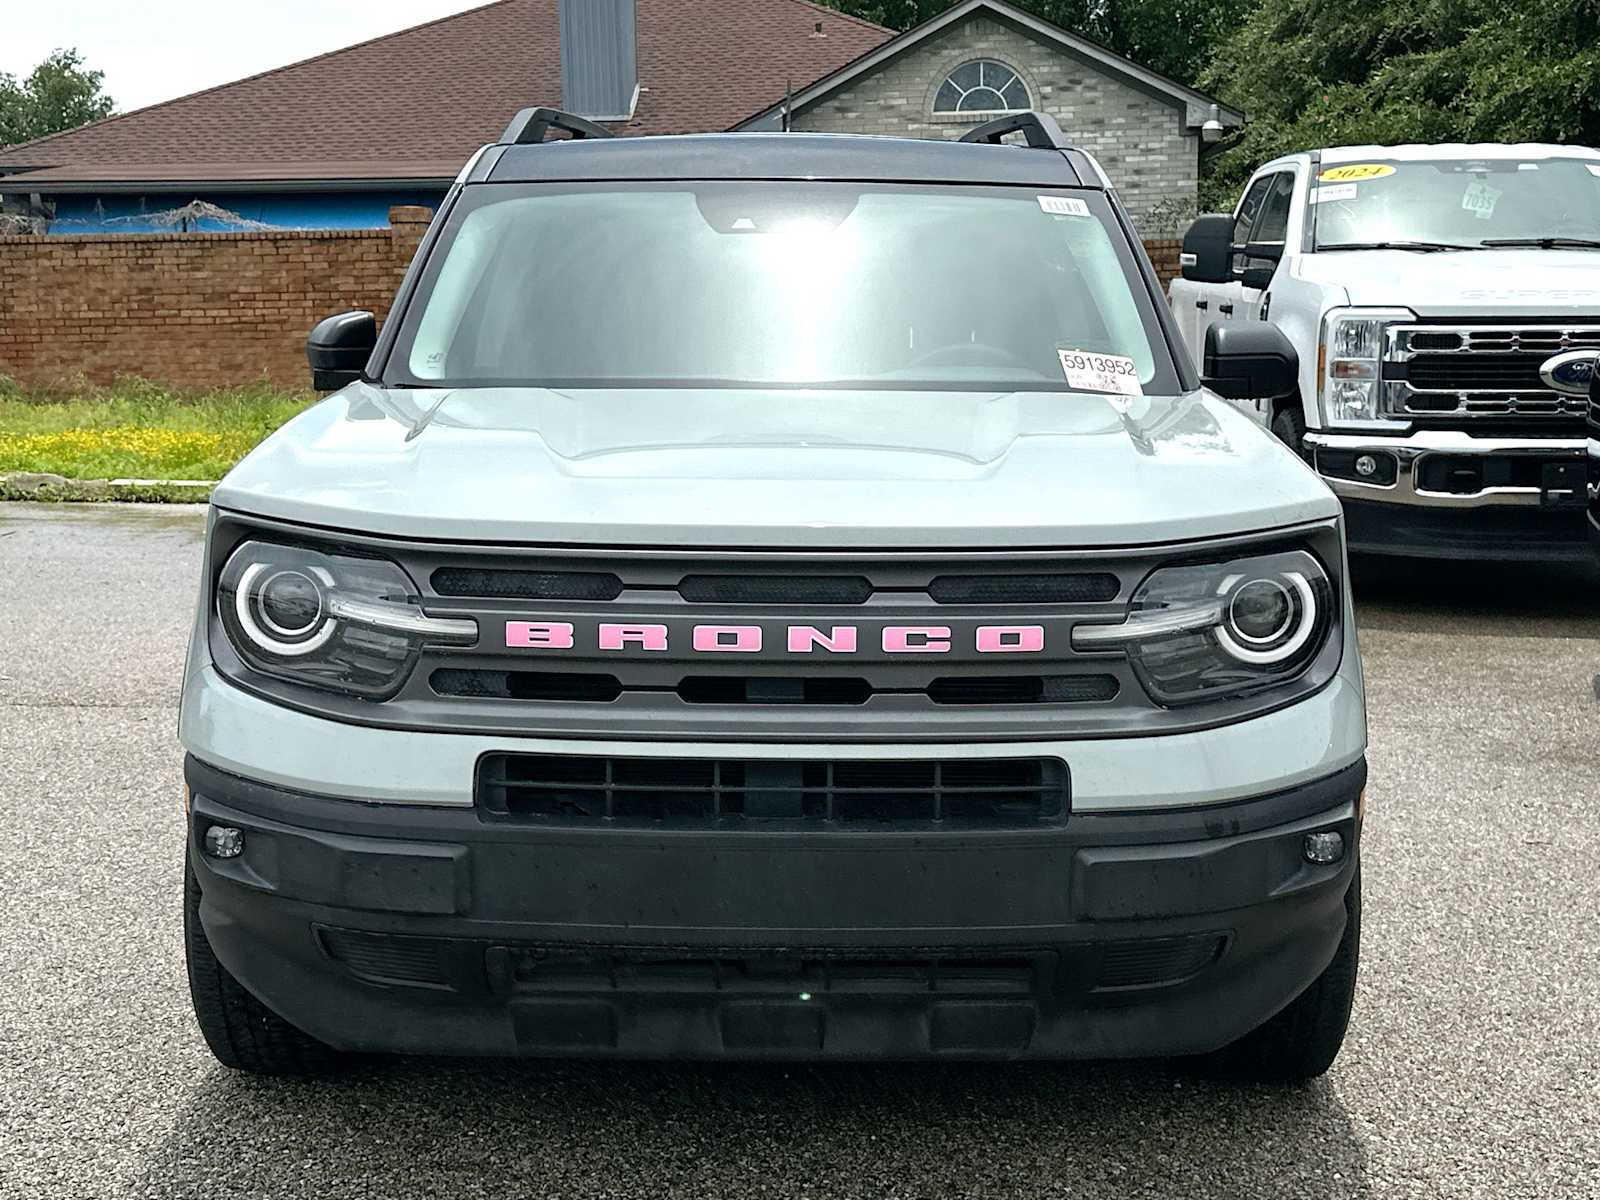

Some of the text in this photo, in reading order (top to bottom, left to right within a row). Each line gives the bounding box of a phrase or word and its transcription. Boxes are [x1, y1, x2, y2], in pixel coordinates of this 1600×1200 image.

[1328, 167, 1384, 180] 2024
[1064, 354, 1137, 376] 5913952
[505, 620, 1045, 653] BRONCO
